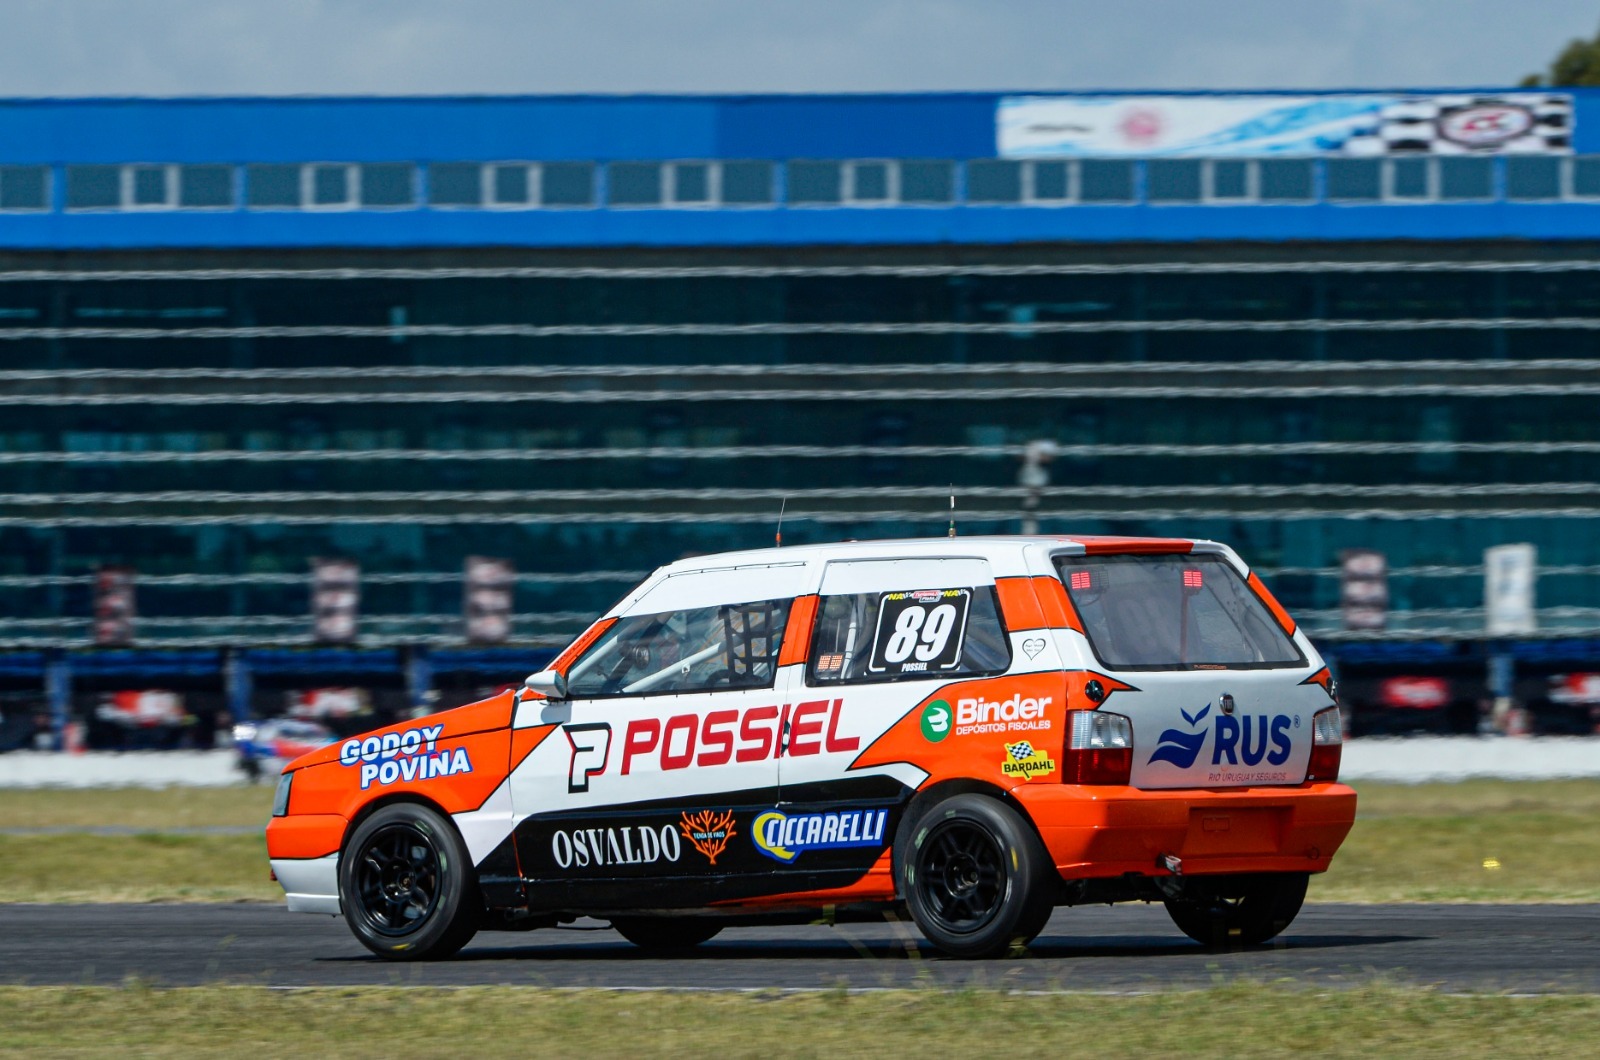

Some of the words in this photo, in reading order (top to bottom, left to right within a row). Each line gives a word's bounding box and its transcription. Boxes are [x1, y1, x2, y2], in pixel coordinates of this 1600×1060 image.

[884, 604, 957, 663] 89
[901, 662, 928, 672] POSSIEL
[956, 694, 1052, 725] Binder
[956, 722, 1006, 736] DEPÓSITOS
[1007, 720, 1051, 731] FISCALES
[340, 725, 444, 766] GODOY
[620, 698, 860, 775] POSSIEL
[1211, 714, 1292, 766] RUS
[1003, 760, 1054, 773] BARDAHL
[1222, 773, 1254, 781] URUGUAY
[1256, 772, 1286, 780] SEGUROS
[552, 824, 681, 868] OSVALDO
[766, 811, 886, 848] CICCARELLI
